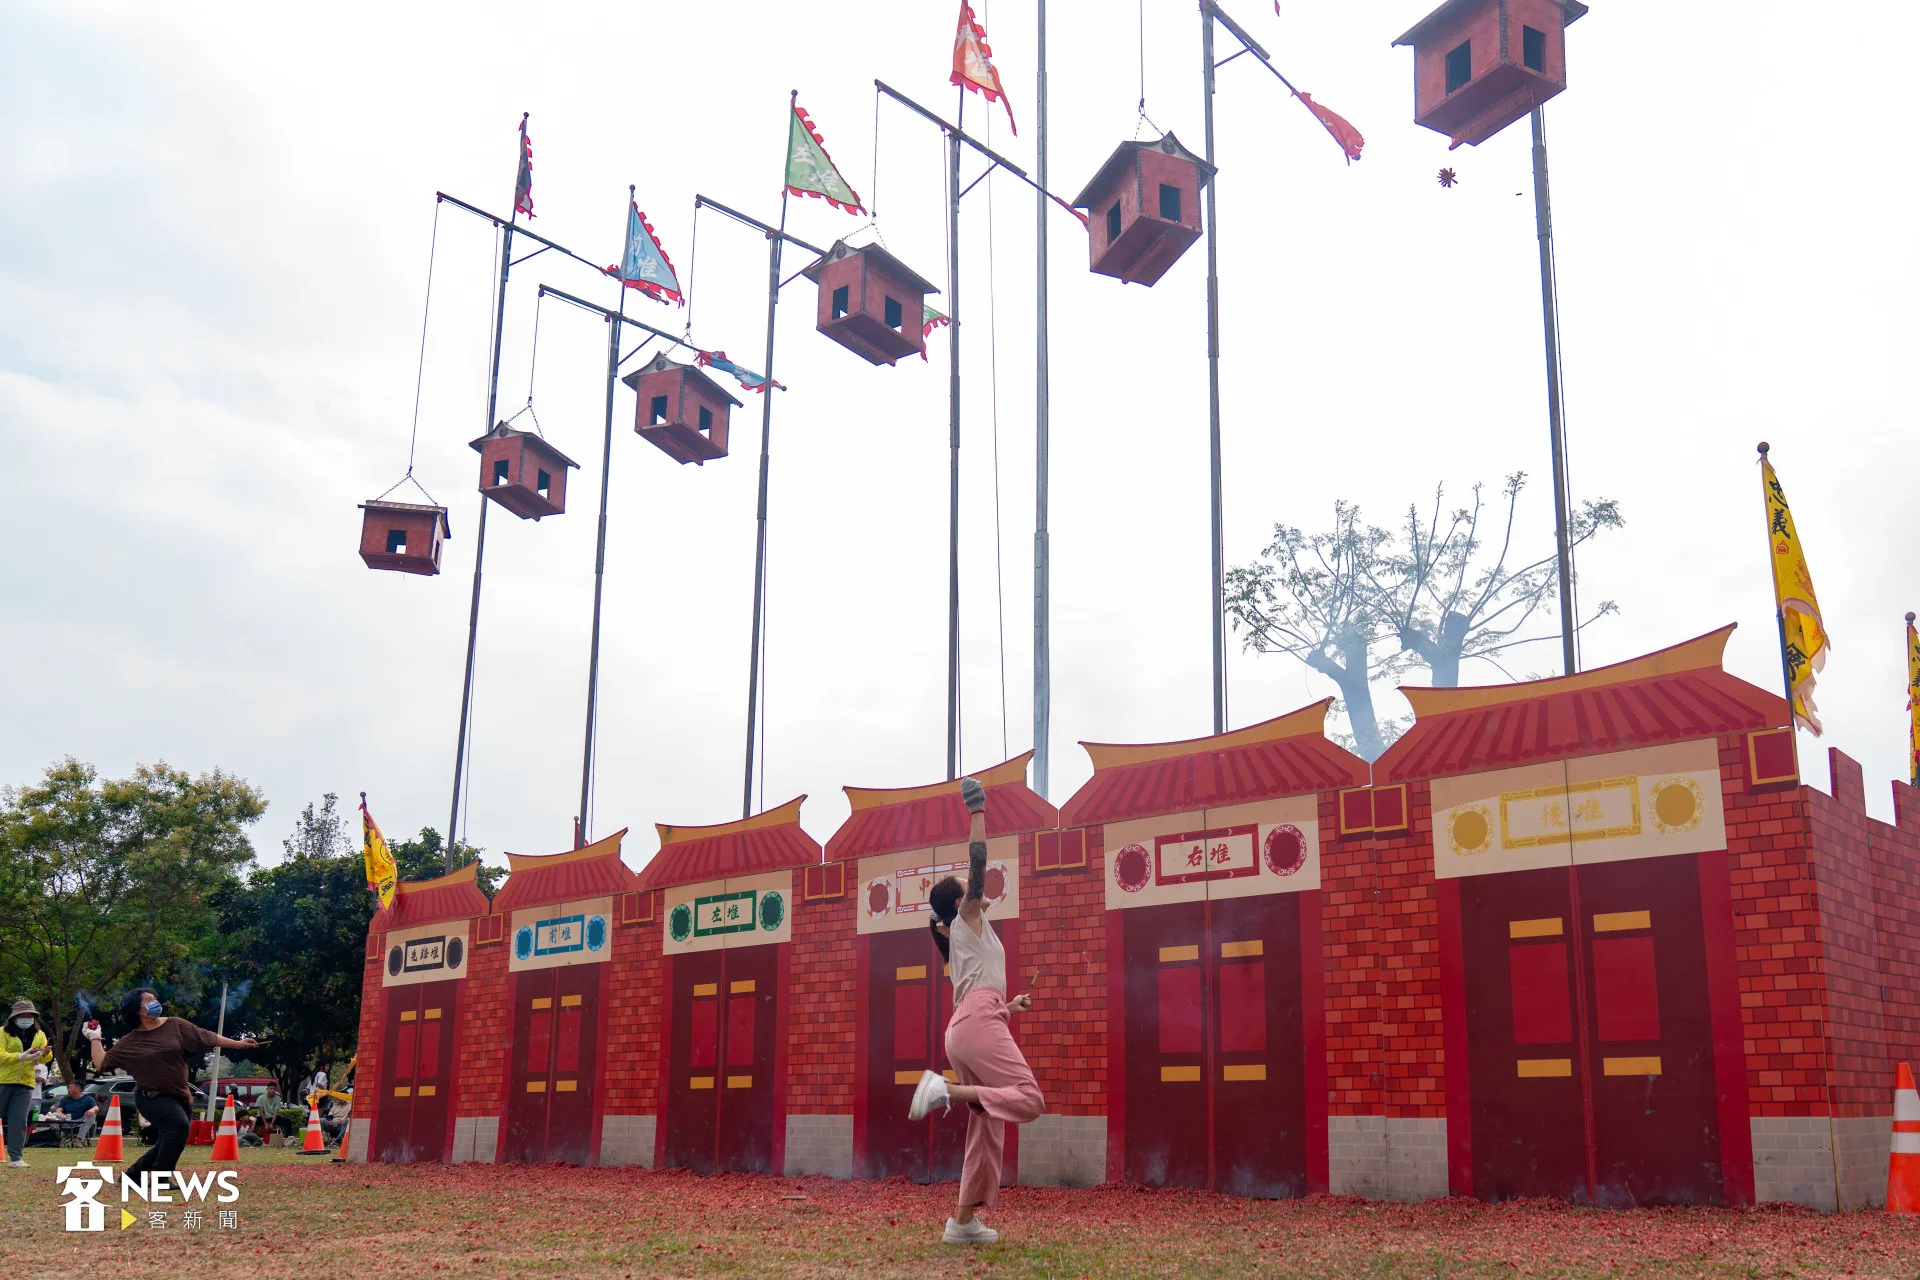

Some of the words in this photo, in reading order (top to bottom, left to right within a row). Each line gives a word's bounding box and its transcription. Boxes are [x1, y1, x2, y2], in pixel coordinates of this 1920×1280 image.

[1542, 799, 1605, 828] 後堆
[1185, 843, 1231, 867] 右堆
[711, 904, 740, 923] 左堆
[549, 926, 572, 944] 前堆
